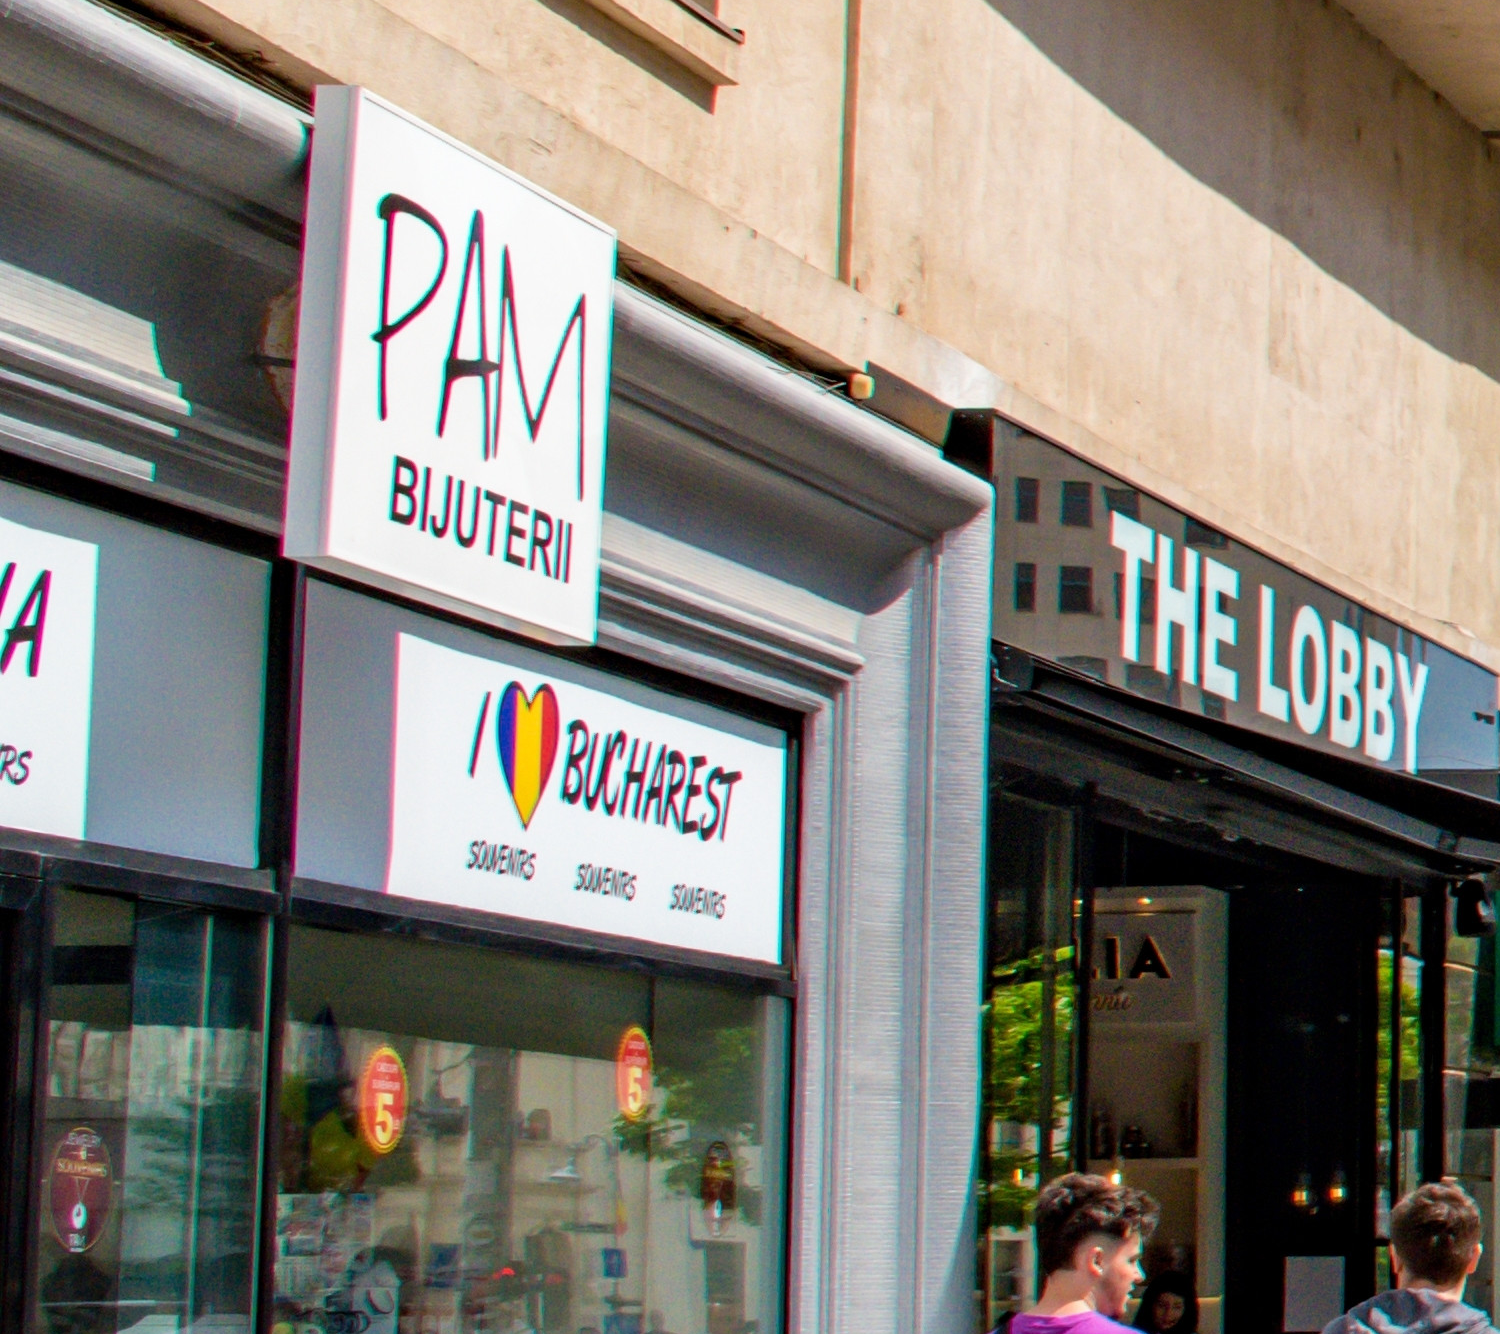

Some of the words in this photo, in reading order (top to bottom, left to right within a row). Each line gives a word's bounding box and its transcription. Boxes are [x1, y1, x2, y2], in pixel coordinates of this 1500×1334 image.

[371, 193, 586, 502] PAM
[389, 455, 573, 584] BIJUTERII
[1109, 509, 1240, 702] THE
[1256, 583, 1430, 775] LOBBY
[468, 690, 491, 779] I
[560, 719, 743, 842] BUCHAREST
[466, 840, 537, 880] SOUVENIRS
[574, 863, 637, 901] SOUVENIRS
[669, 883, 727, 919] SOUVENIRS
[376, 1092, 395, 1145] 5
[628, 1066, 643, 1113] 5
